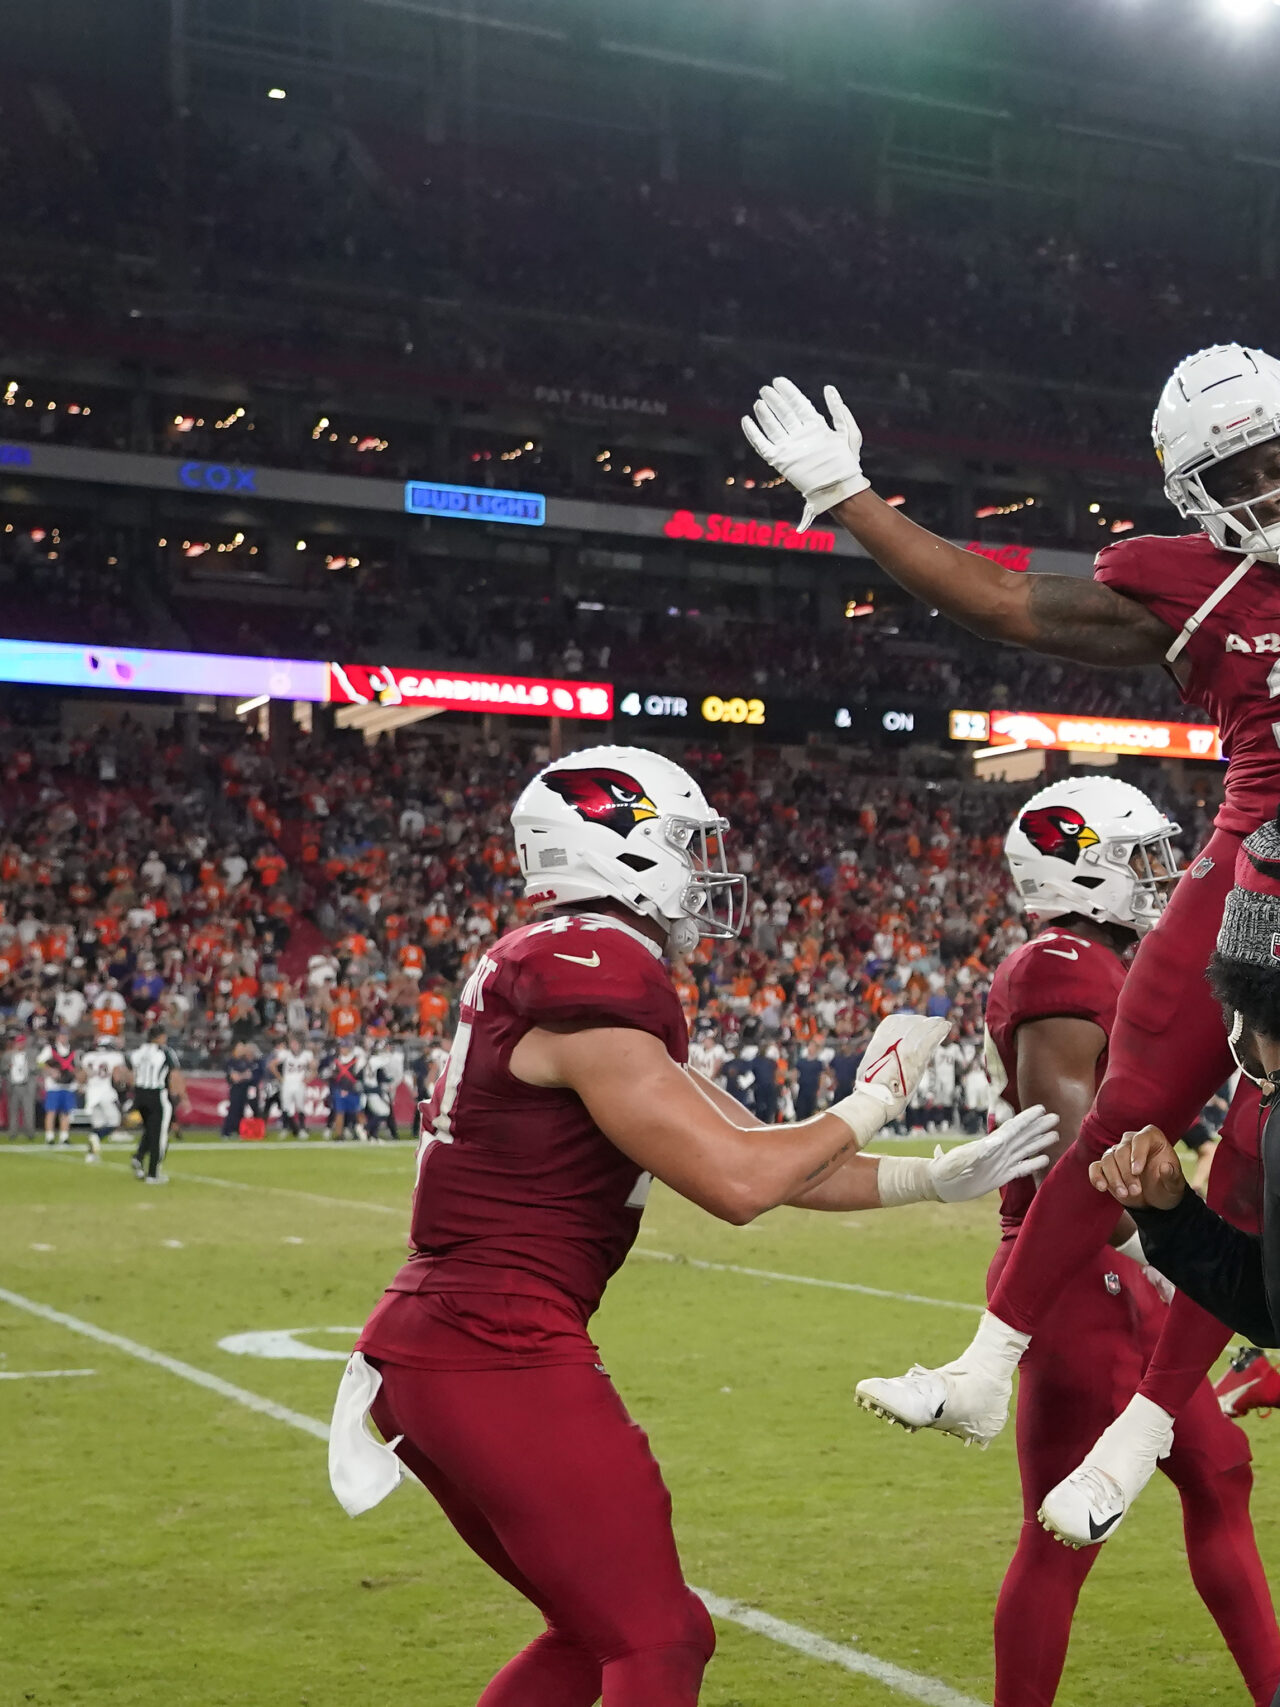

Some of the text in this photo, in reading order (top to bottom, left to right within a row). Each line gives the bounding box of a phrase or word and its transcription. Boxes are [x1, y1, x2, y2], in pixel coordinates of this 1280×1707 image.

[580, 390, 668, 416] TILLMAN
[178, 460, 257, 491] COX
[469, 493, 539, 519] LIGHT
[399, 676, 549, 706] CARDINALS
[620, 692, 766, 725] 4 QTR 0:02
[882, 710, 914, 732] ON
[1056, 721, 1214, 754] BRONCOS 17
